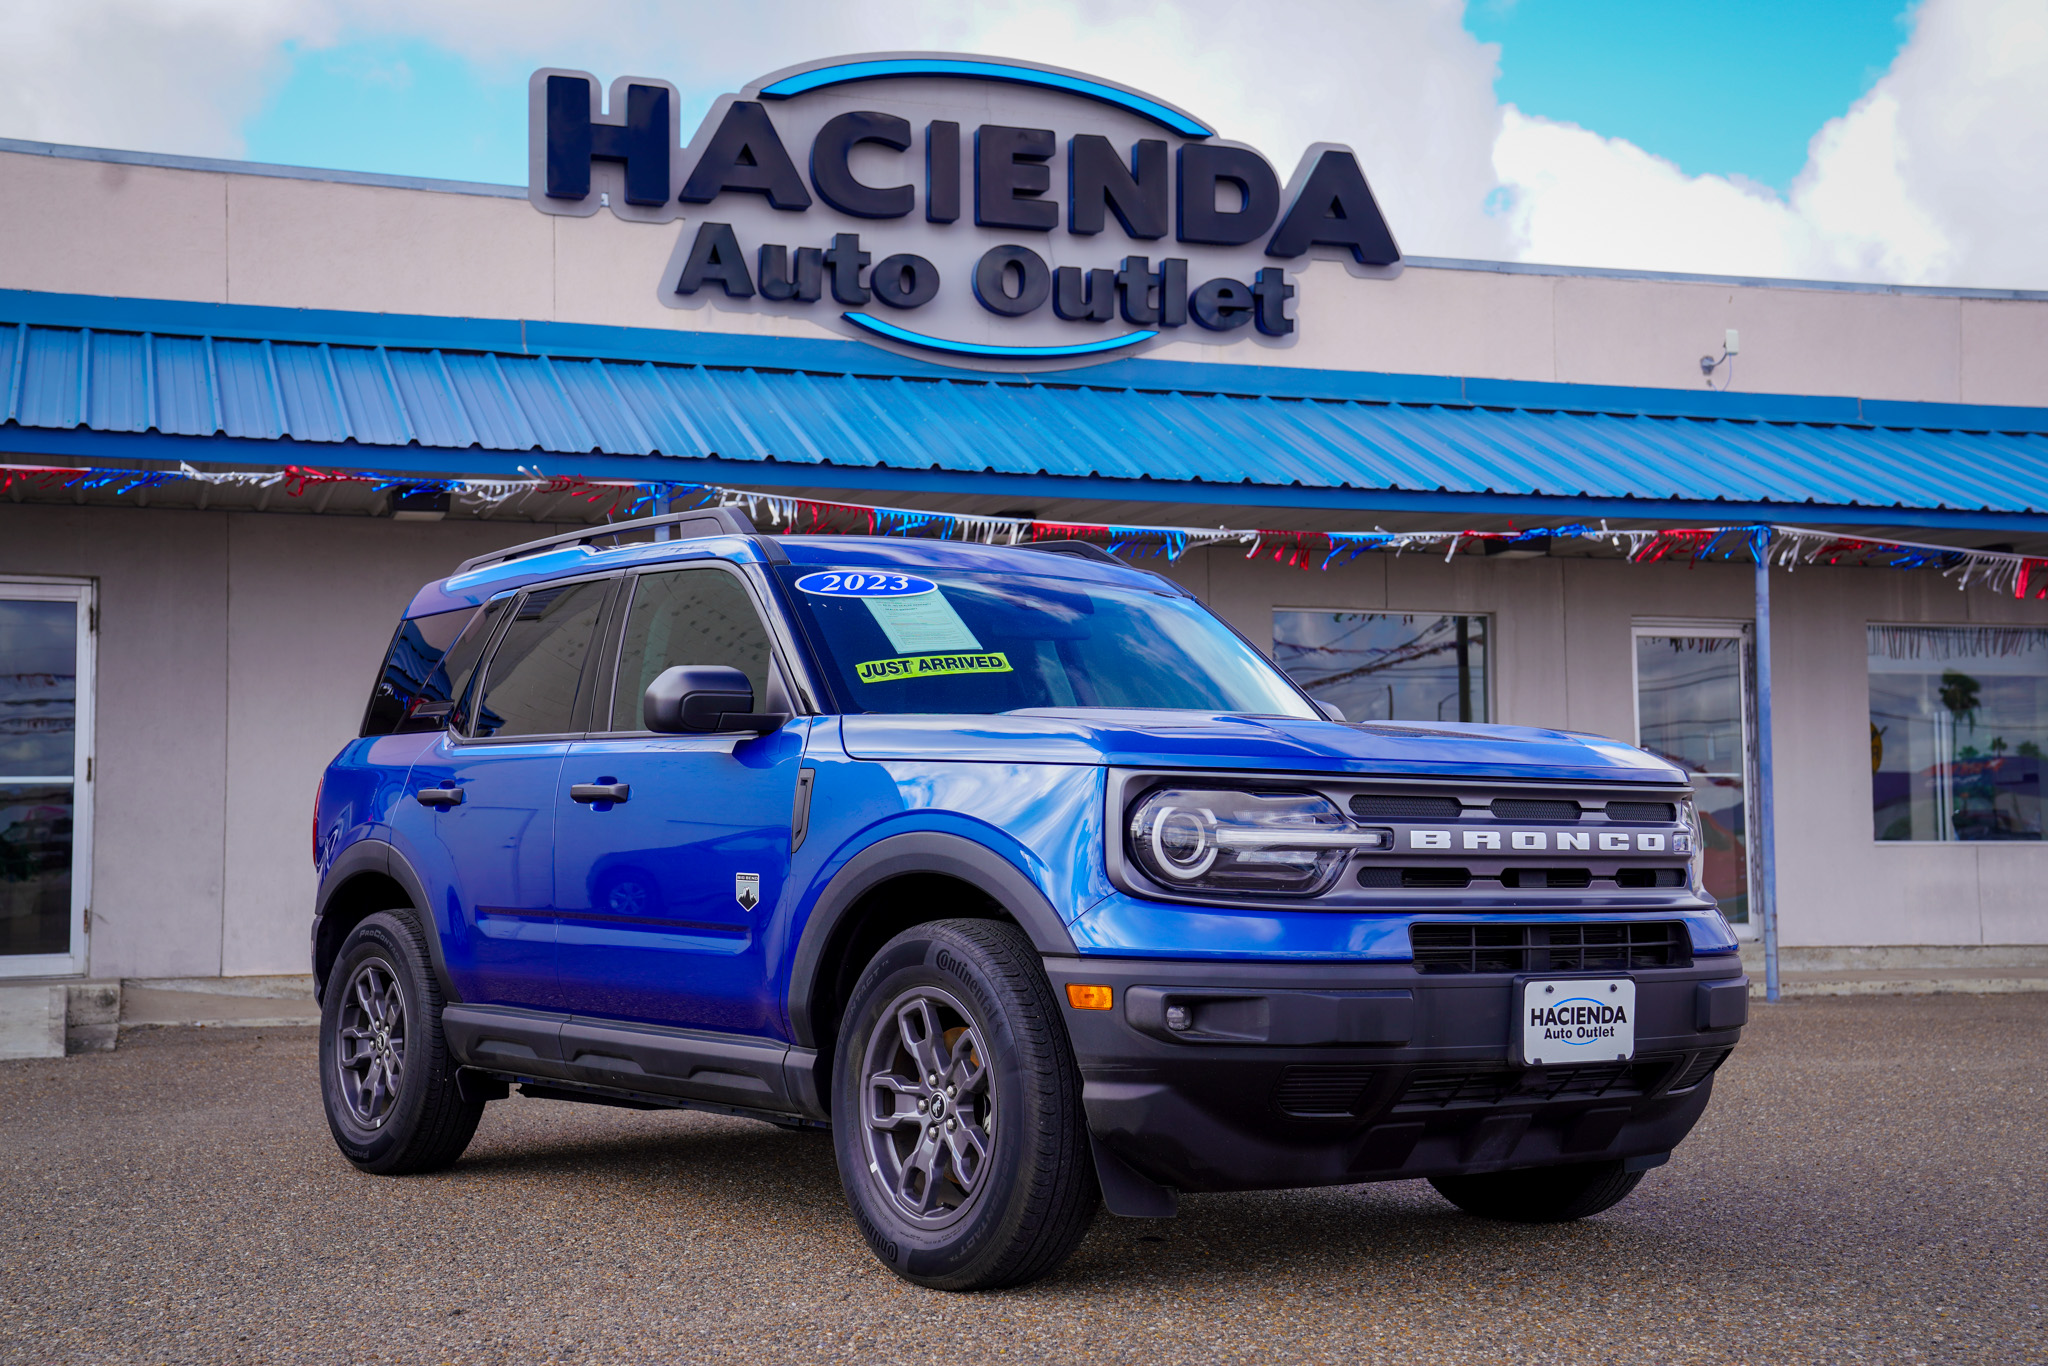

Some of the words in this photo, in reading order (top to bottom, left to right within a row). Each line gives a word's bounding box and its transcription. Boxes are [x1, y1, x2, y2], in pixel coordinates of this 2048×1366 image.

[545, 74, 1401, 266] HACIENDA
[674, 221, 940, 310] Auto
[972, 243, 1295, 337] Outlet
[820, 574, 909, 591] 2023
[860, 660, 912, 678] JUST
[918, 656, 1004, 672] ARRIVED
[1410, 830, 1665, 850] BRONCO
[935, 948, 999, 1022] Continental
[1531, 1006, 1627, 1026] HACIENDA
[1544, 1027, 1573, 1039] Auto
[1577, 1026, 1615, 1038] Outlet
